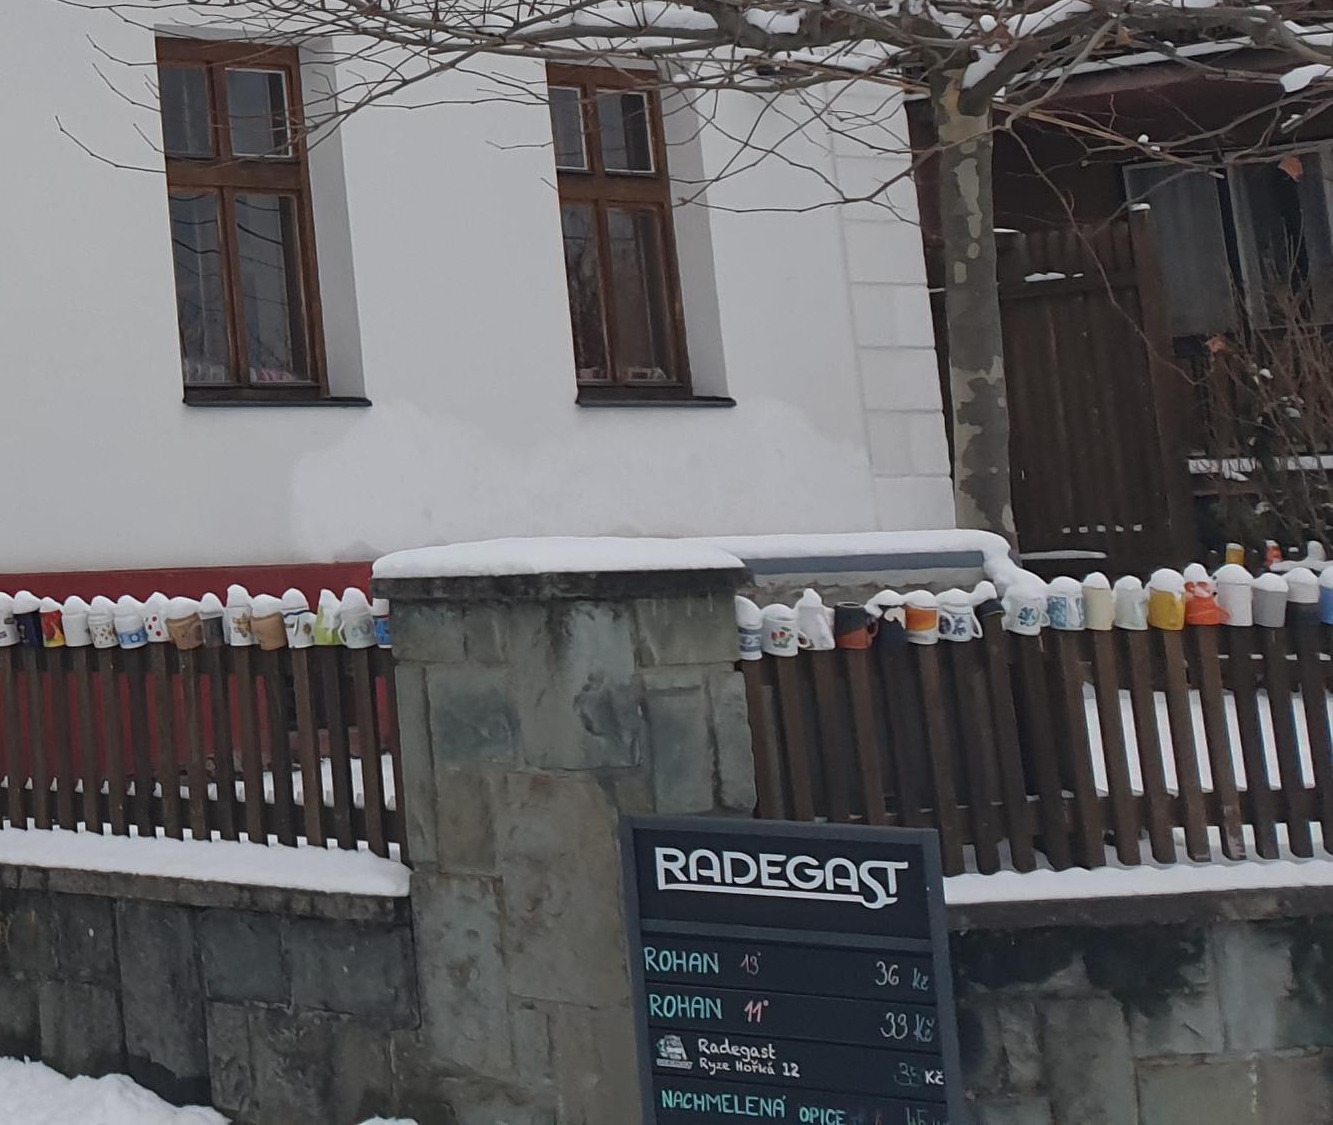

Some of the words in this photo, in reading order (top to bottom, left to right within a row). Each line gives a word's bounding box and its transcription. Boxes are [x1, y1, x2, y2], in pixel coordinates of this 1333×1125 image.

[654, 846, 909, 909] RADEGAST
[643, 946, 720, 974] ROHAN
[875, 961, 900, 986] 36
[648, 994, 723, 1019] ROHAN
[698, 1037, 776, 1062] Radegast
[699, 1057, 731, 1075] Ryze
[736, 1059, 776, 1076] Hořká
[782, 1062, 801, 1078] 12
[924, 1069, 945, 1085] Kč
[661, 1089, 787, 1119] NACHMELENÁ
[799, 1106, 846, 1125] OPICE
